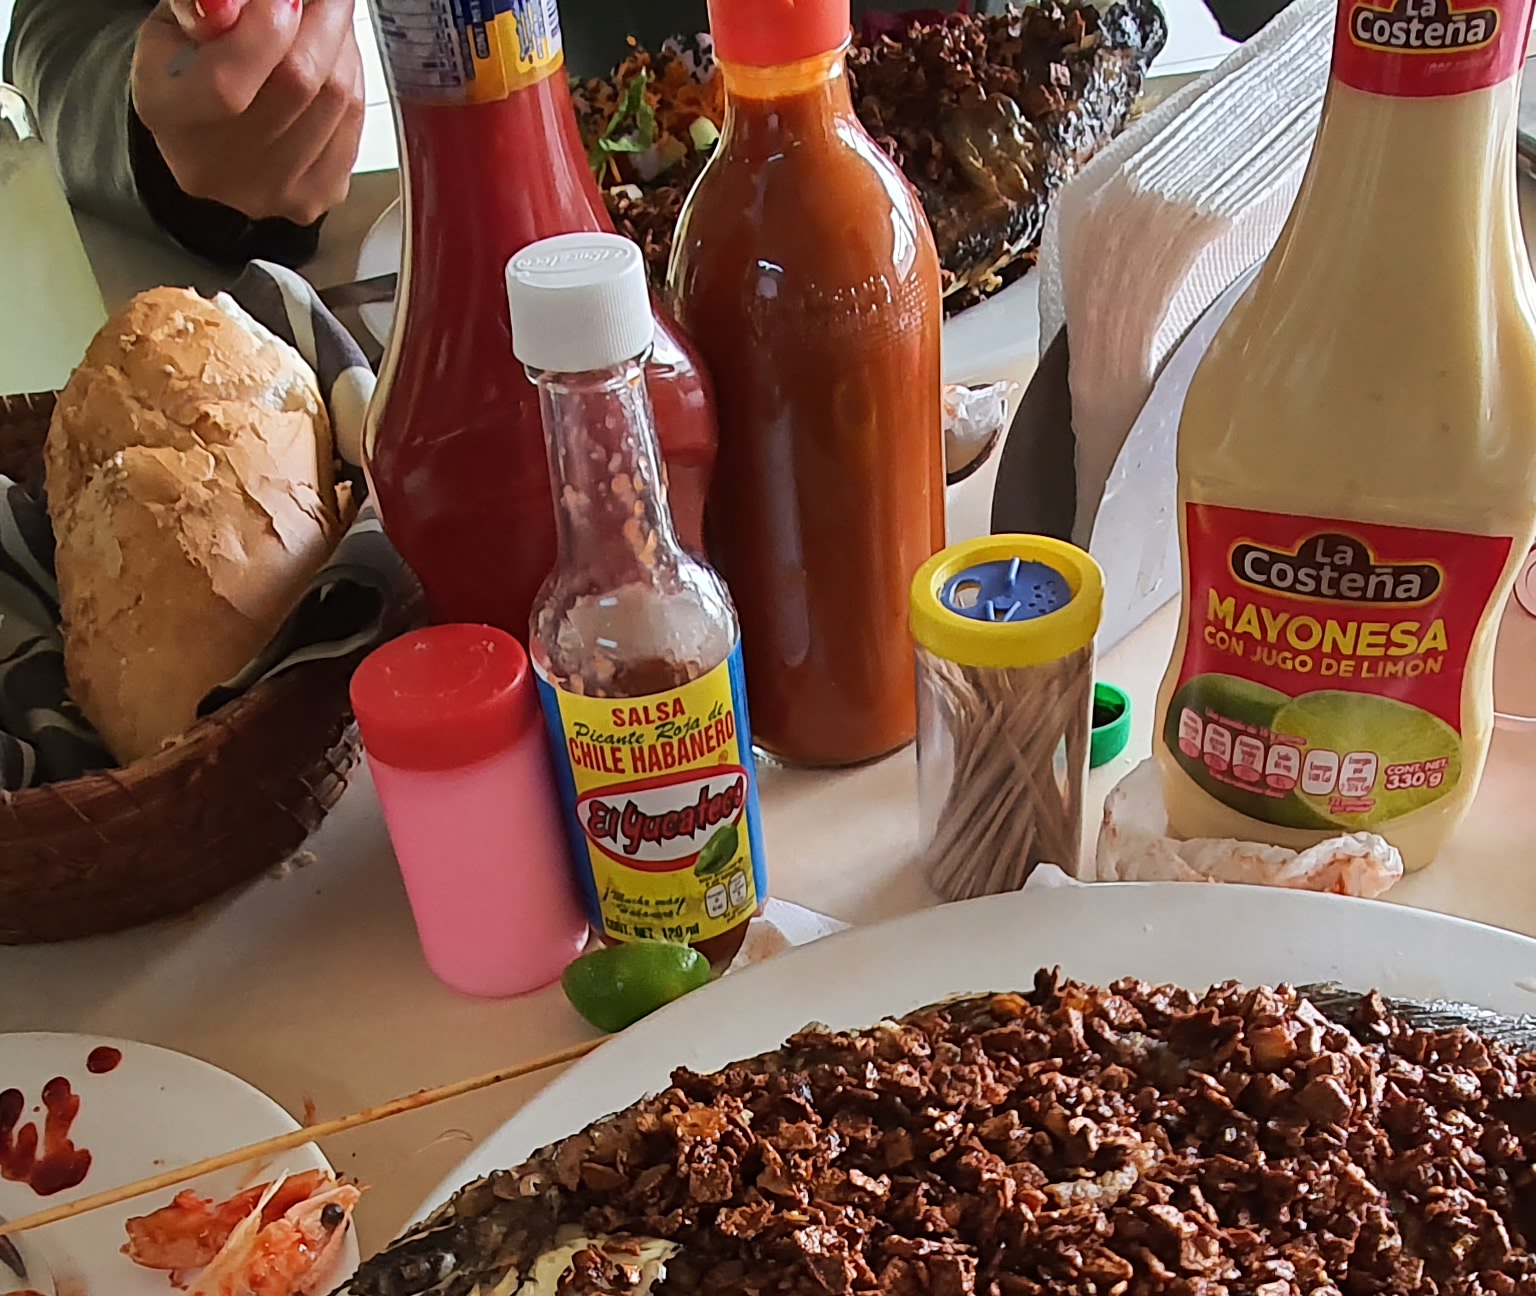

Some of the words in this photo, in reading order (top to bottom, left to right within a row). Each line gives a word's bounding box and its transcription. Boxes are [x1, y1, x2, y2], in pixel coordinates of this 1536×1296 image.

[1405, 0, 1438, 17] La
[1356, 13, 1487, 47] Costeña
[1314, 538, 1354, 566] La
[1243, 551, 1422, 599] Costeña
[1207, 588, 1448, 657] MAYONESA
[1204, 626, 1244, 657] CON
[1250, 646, 1314, 674] JUGO
[1320, 658, 1356, 677] DE
[573, 722, 645, 745] Picante
[655, 717, 700, 742] Roja
[707, 700, 724, 720] de
[611, 697, 685, 727] SALSA
[568, 737, 626, 774] CHILE
[630, 710, 734, 774] HABANERO
[1386, 763, 1422, 775] CONT.
[1386, 771, 1426, 789] 330
[1428, 772, 1443, 787] g
[587, 799, 621, 844] El
[620, 775, 744, 855] Yucateco
